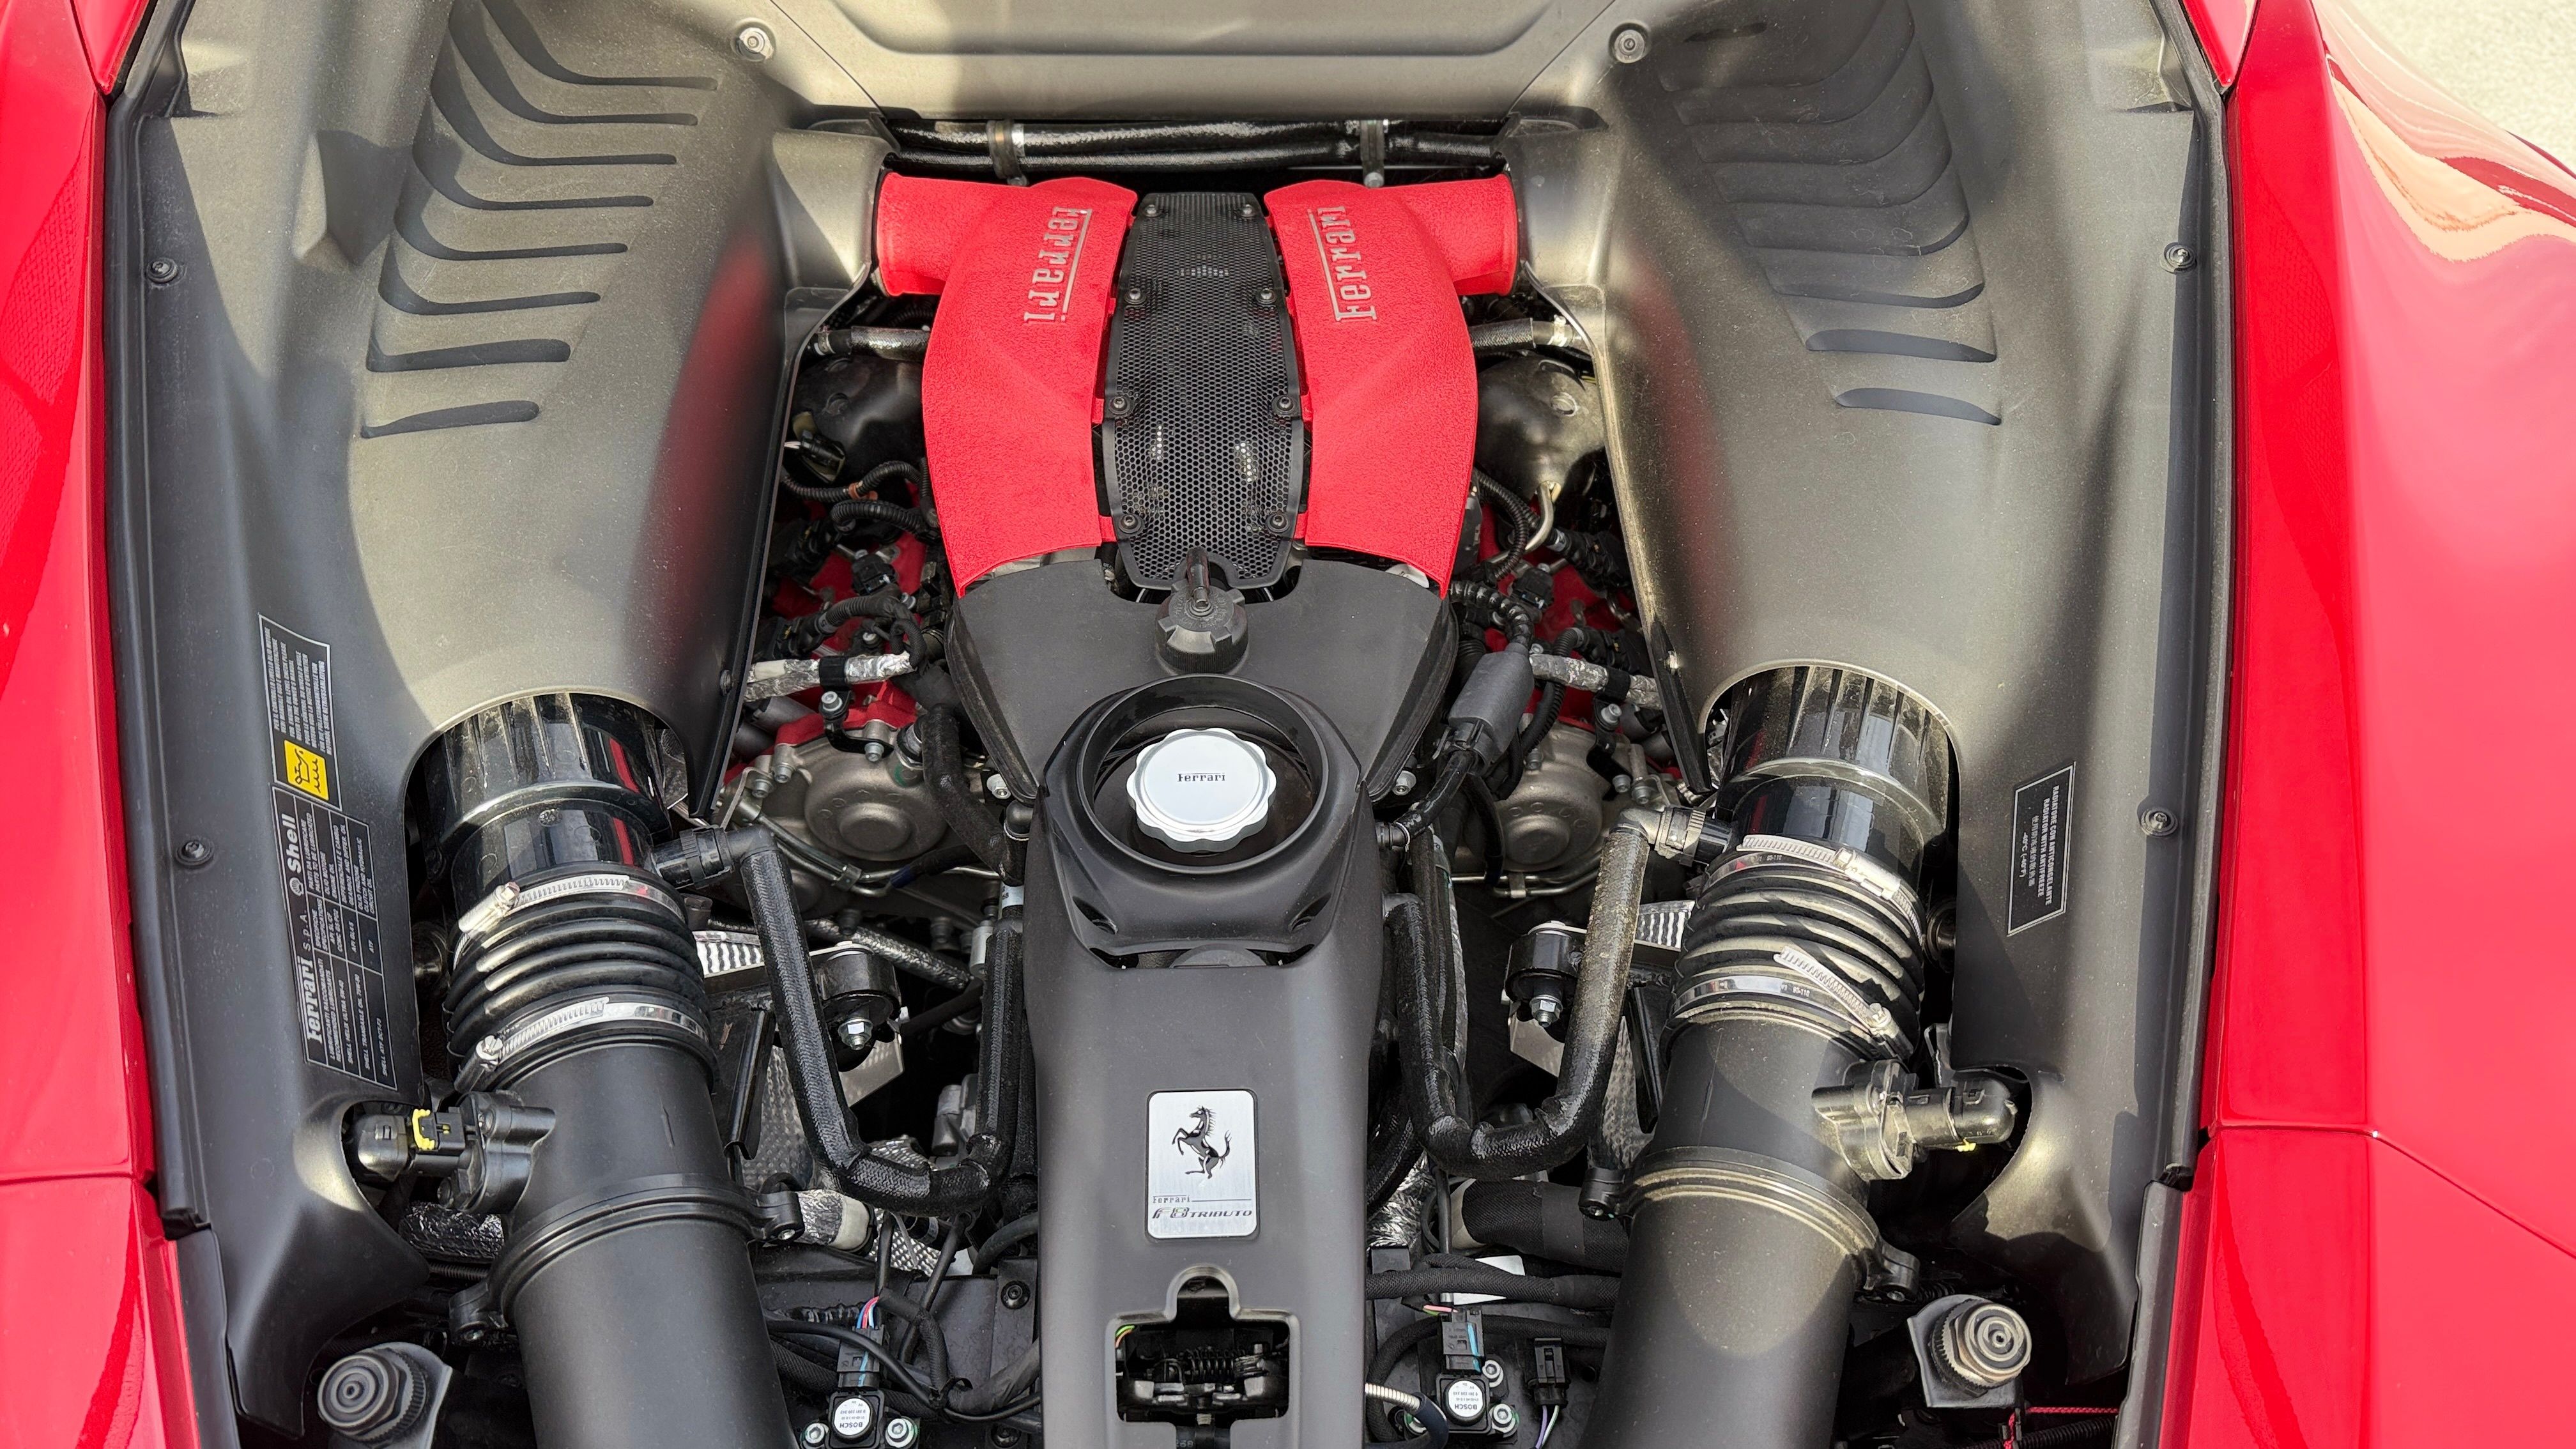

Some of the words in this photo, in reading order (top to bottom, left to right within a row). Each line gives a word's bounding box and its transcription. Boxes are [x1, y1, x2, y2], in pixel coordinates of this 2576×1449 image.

[1023, 206, 1094, 324] Ferrari
[1307, 206, 1377, 321] Ferrari
[270, 680, 278, 713] CONTROLLO
[307, 705, 313, 713] LA
[294, 715, 300, 723] TO
[1177, 772, 1226, 783] Ferrari
[2041, 797, 2050, 834] RADIATOR
[2050, 785, 2059, 825] RADIATORE
[281, 813, 302, 874] Shell
[300, 818, 310, 860] LUBRIFICARE
[305, 811, 316, 852] LUBRICATED
[305, 859, 312, 870] DA
[310, 850, 317, 861] BE
[312, 860, 318, 871] TO
[319, 850, 328, 878] MOTORE
[356, 836, 365, 873] HYDRAULIC
[2044, 840, 2055, 907] ANTICONGELANTE
[337, 855, 347, 903] DIFFERENZIALE
[346, 873, 354, 906] GEARBOX
[2037, 852, 2046, 898] ANTIFREEZE
[298, 907, 312, 953] S.p.A.
[311, 908, 321, 948] SPECIFICHE
[316, 897, 328, 951] SPECIFICATIONS
[296, 954, 323, 1045] Ferrari
[317, 957, 329, 1011] RACCOMANDATI
[325, 969, 335, 1011] LUBRICANTS
[323, 1011, 335, 1060] LUBRIFICANTI
[330, 1010, 341, 1062] RECOMMENDED
[358, 1008, 367, 1047] TRANSAXLE
[1153, 1195, 1190, 1204] Ferrari
[1190, 1209, 1252, 1218] TRIBUTO
